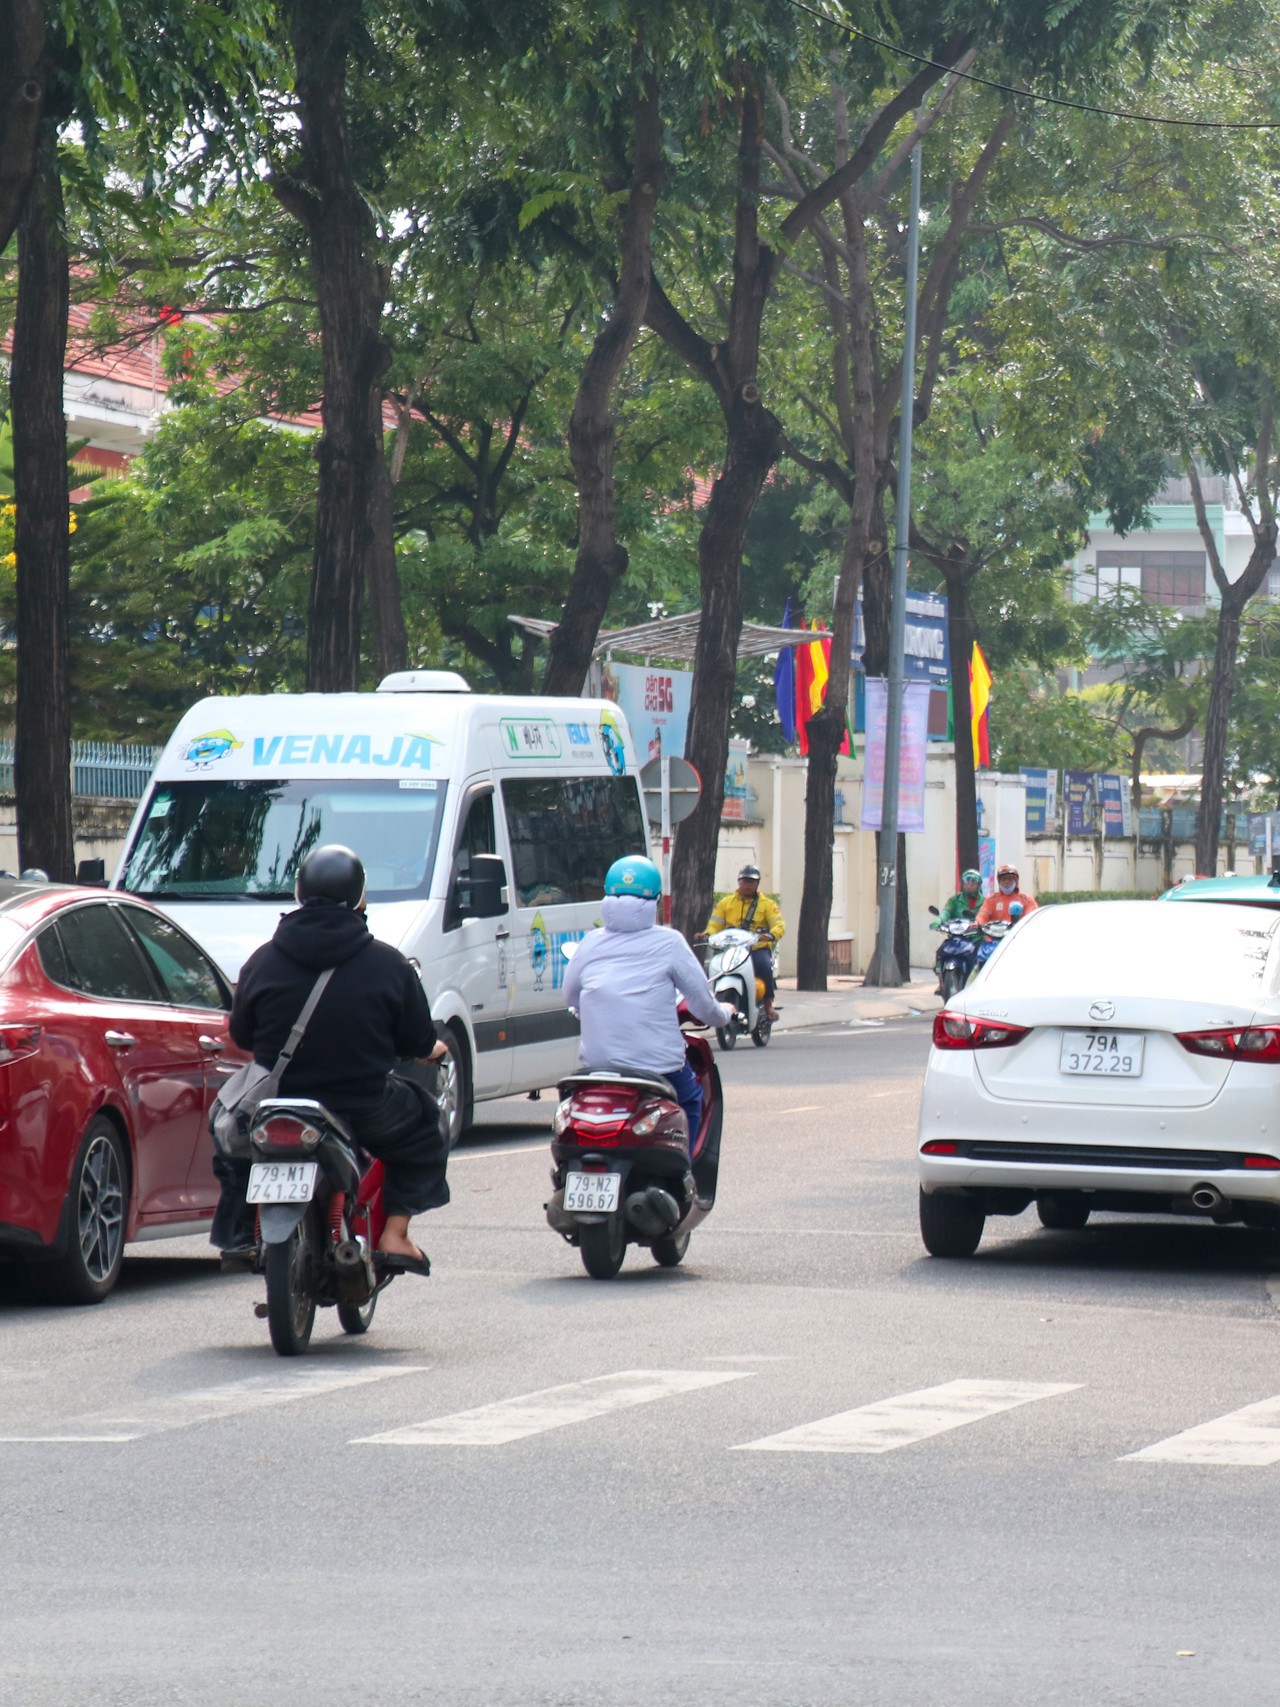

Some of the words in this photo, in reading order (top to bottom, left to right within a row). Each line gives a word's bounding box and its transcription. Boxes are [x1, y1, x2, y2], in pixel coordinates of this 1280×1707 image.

[252, 733, 432, 771] VENAJA
[1085, 1034, 1119, 1053] 79A
[1068, 1054, 1133, 1074] 372.29
[262, 1166, 305, 1182] 79-N1
[251, 1184, 309, 1201] 741.29
[574, 1176, 612, 1192] 79-N2
[568, 1193, 615, 1210] 596.67
